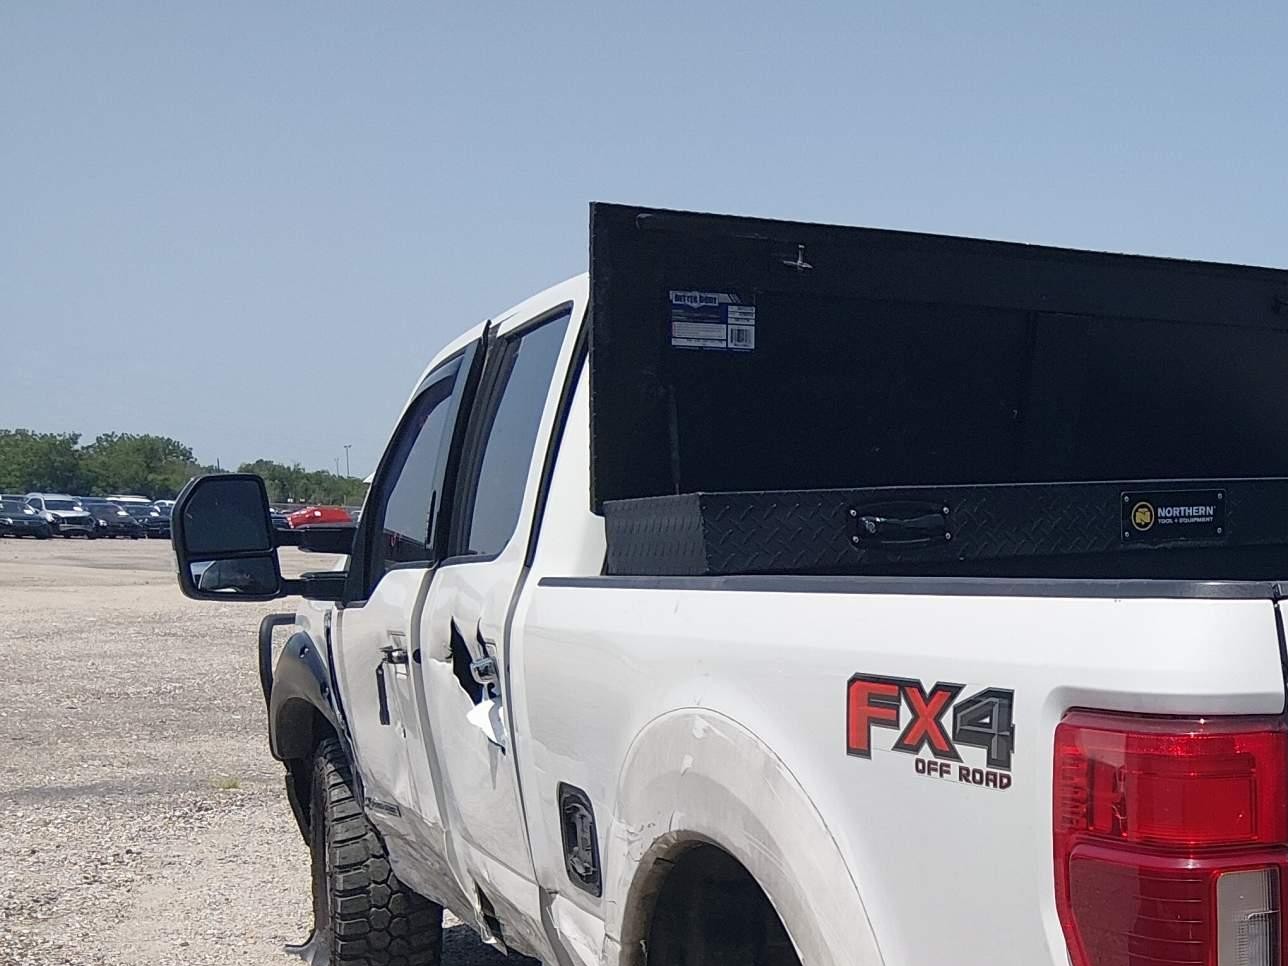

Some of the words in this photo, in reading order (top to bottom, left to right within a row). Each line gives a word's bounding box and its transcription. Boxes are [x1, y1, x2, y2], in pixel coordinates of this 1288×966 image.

[1157, 506, 1214, 517] NORTHERN
[846, 672, 1015, 772] FX4
[915, 758, 952, 779] OFF
[958, 765, 1013, 790] ROAD
